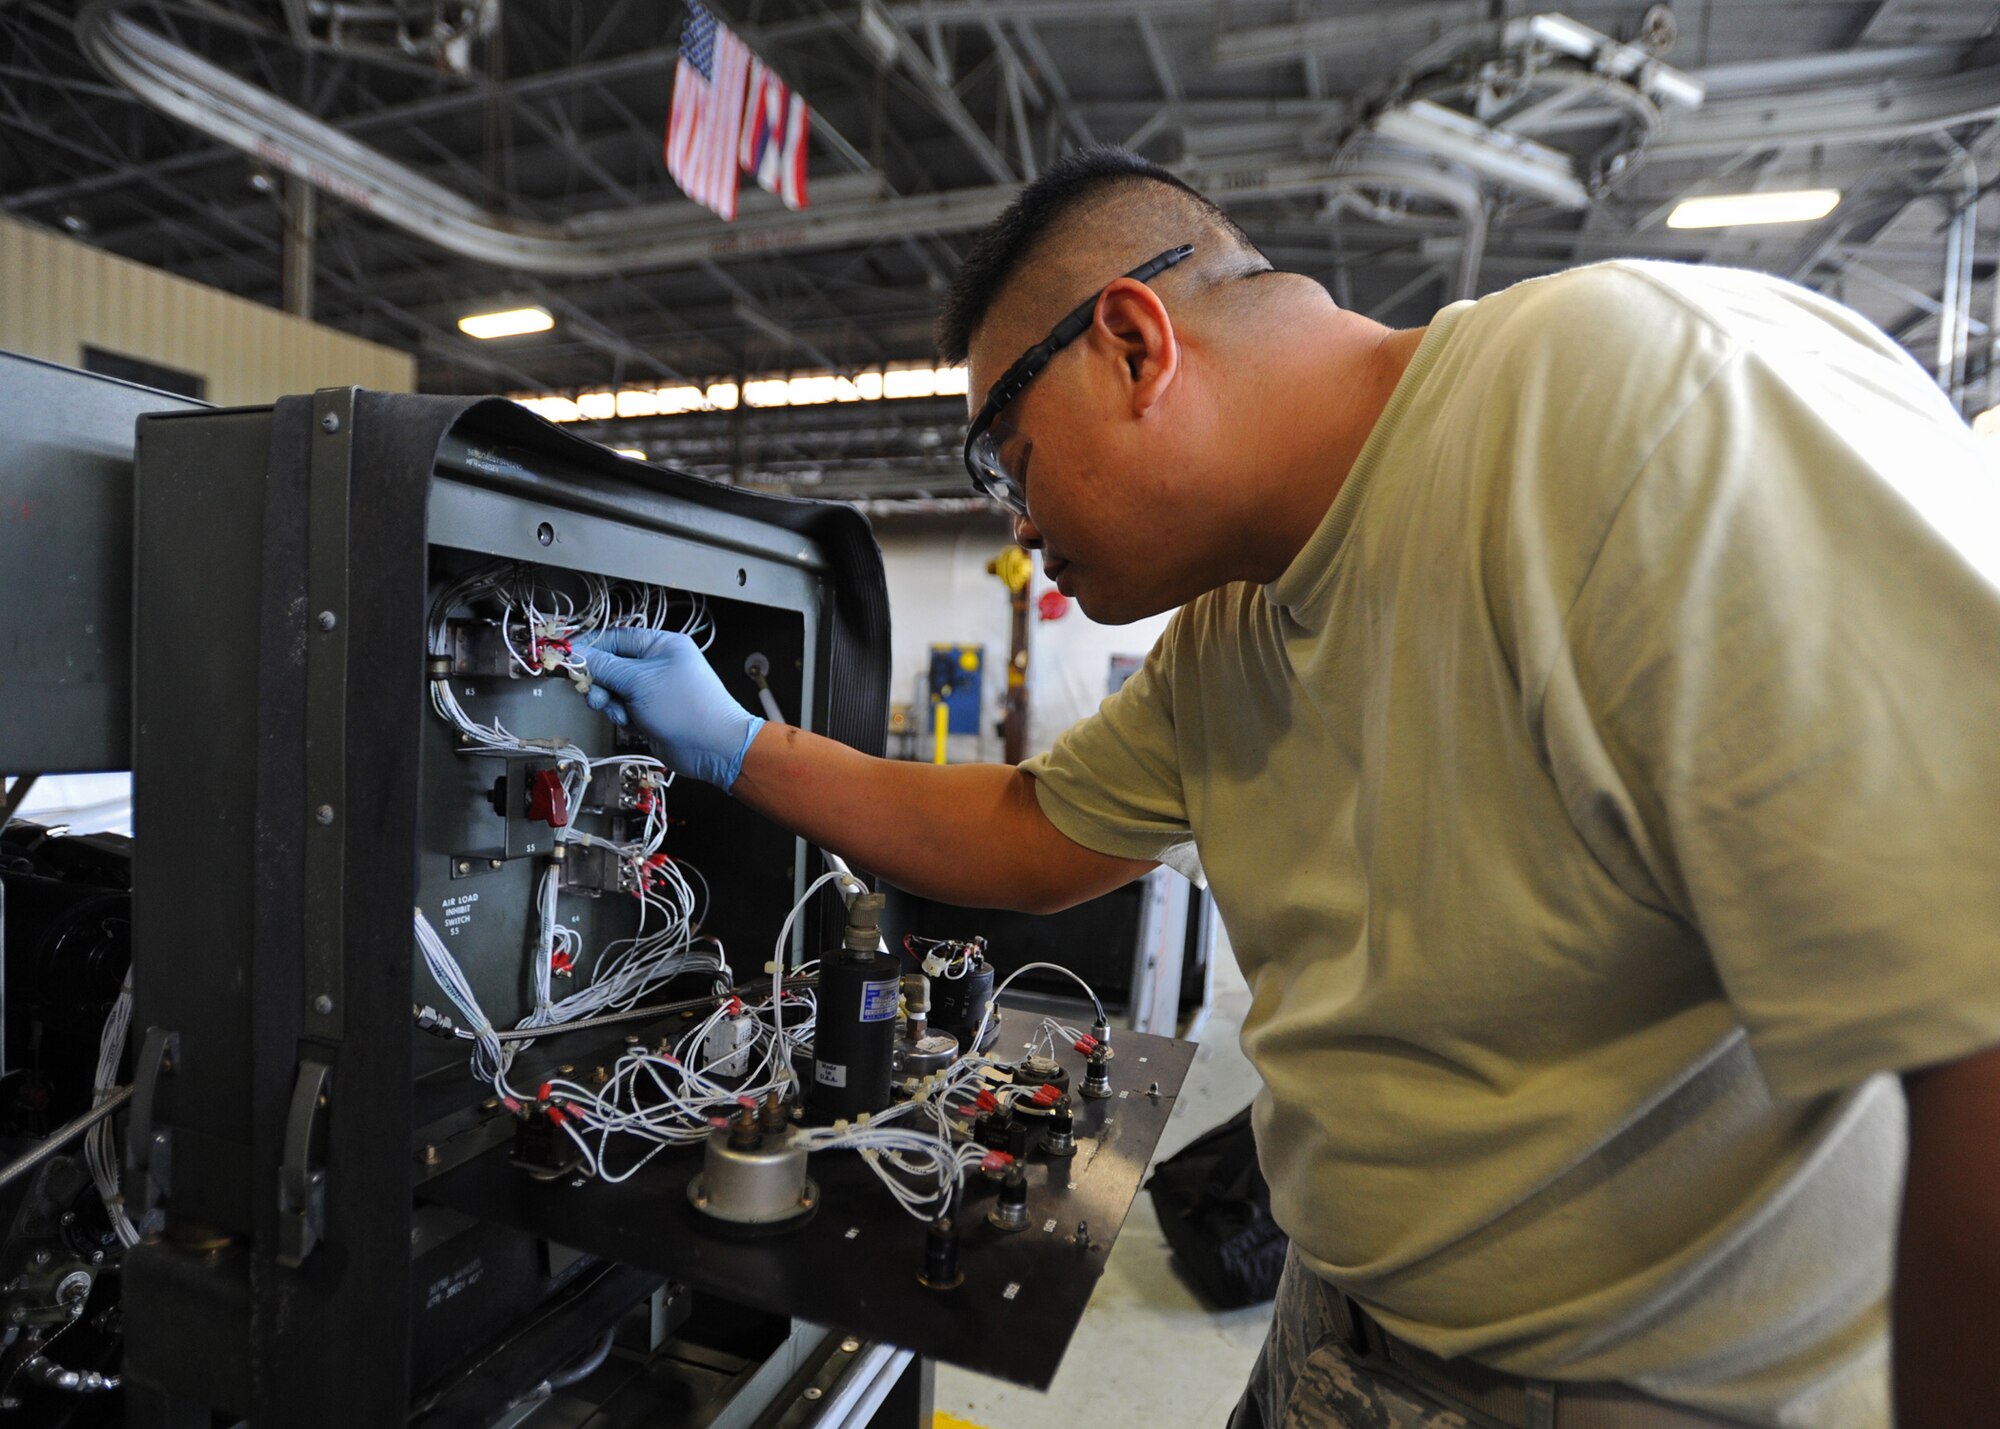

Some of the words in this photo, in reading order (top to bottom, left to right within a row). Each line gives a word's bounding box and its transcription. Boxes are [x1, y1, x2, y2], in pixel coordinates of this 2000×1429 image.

[526, 843, 536, 853] S5
[442, 897, 456, 908] AIR
[458, 893, 479, 905] LOAD
[445, 904, 471, 916] INHIBIT
[444, 915, 471, 927] SWITCH
[450, 927, 460, 936] S5
